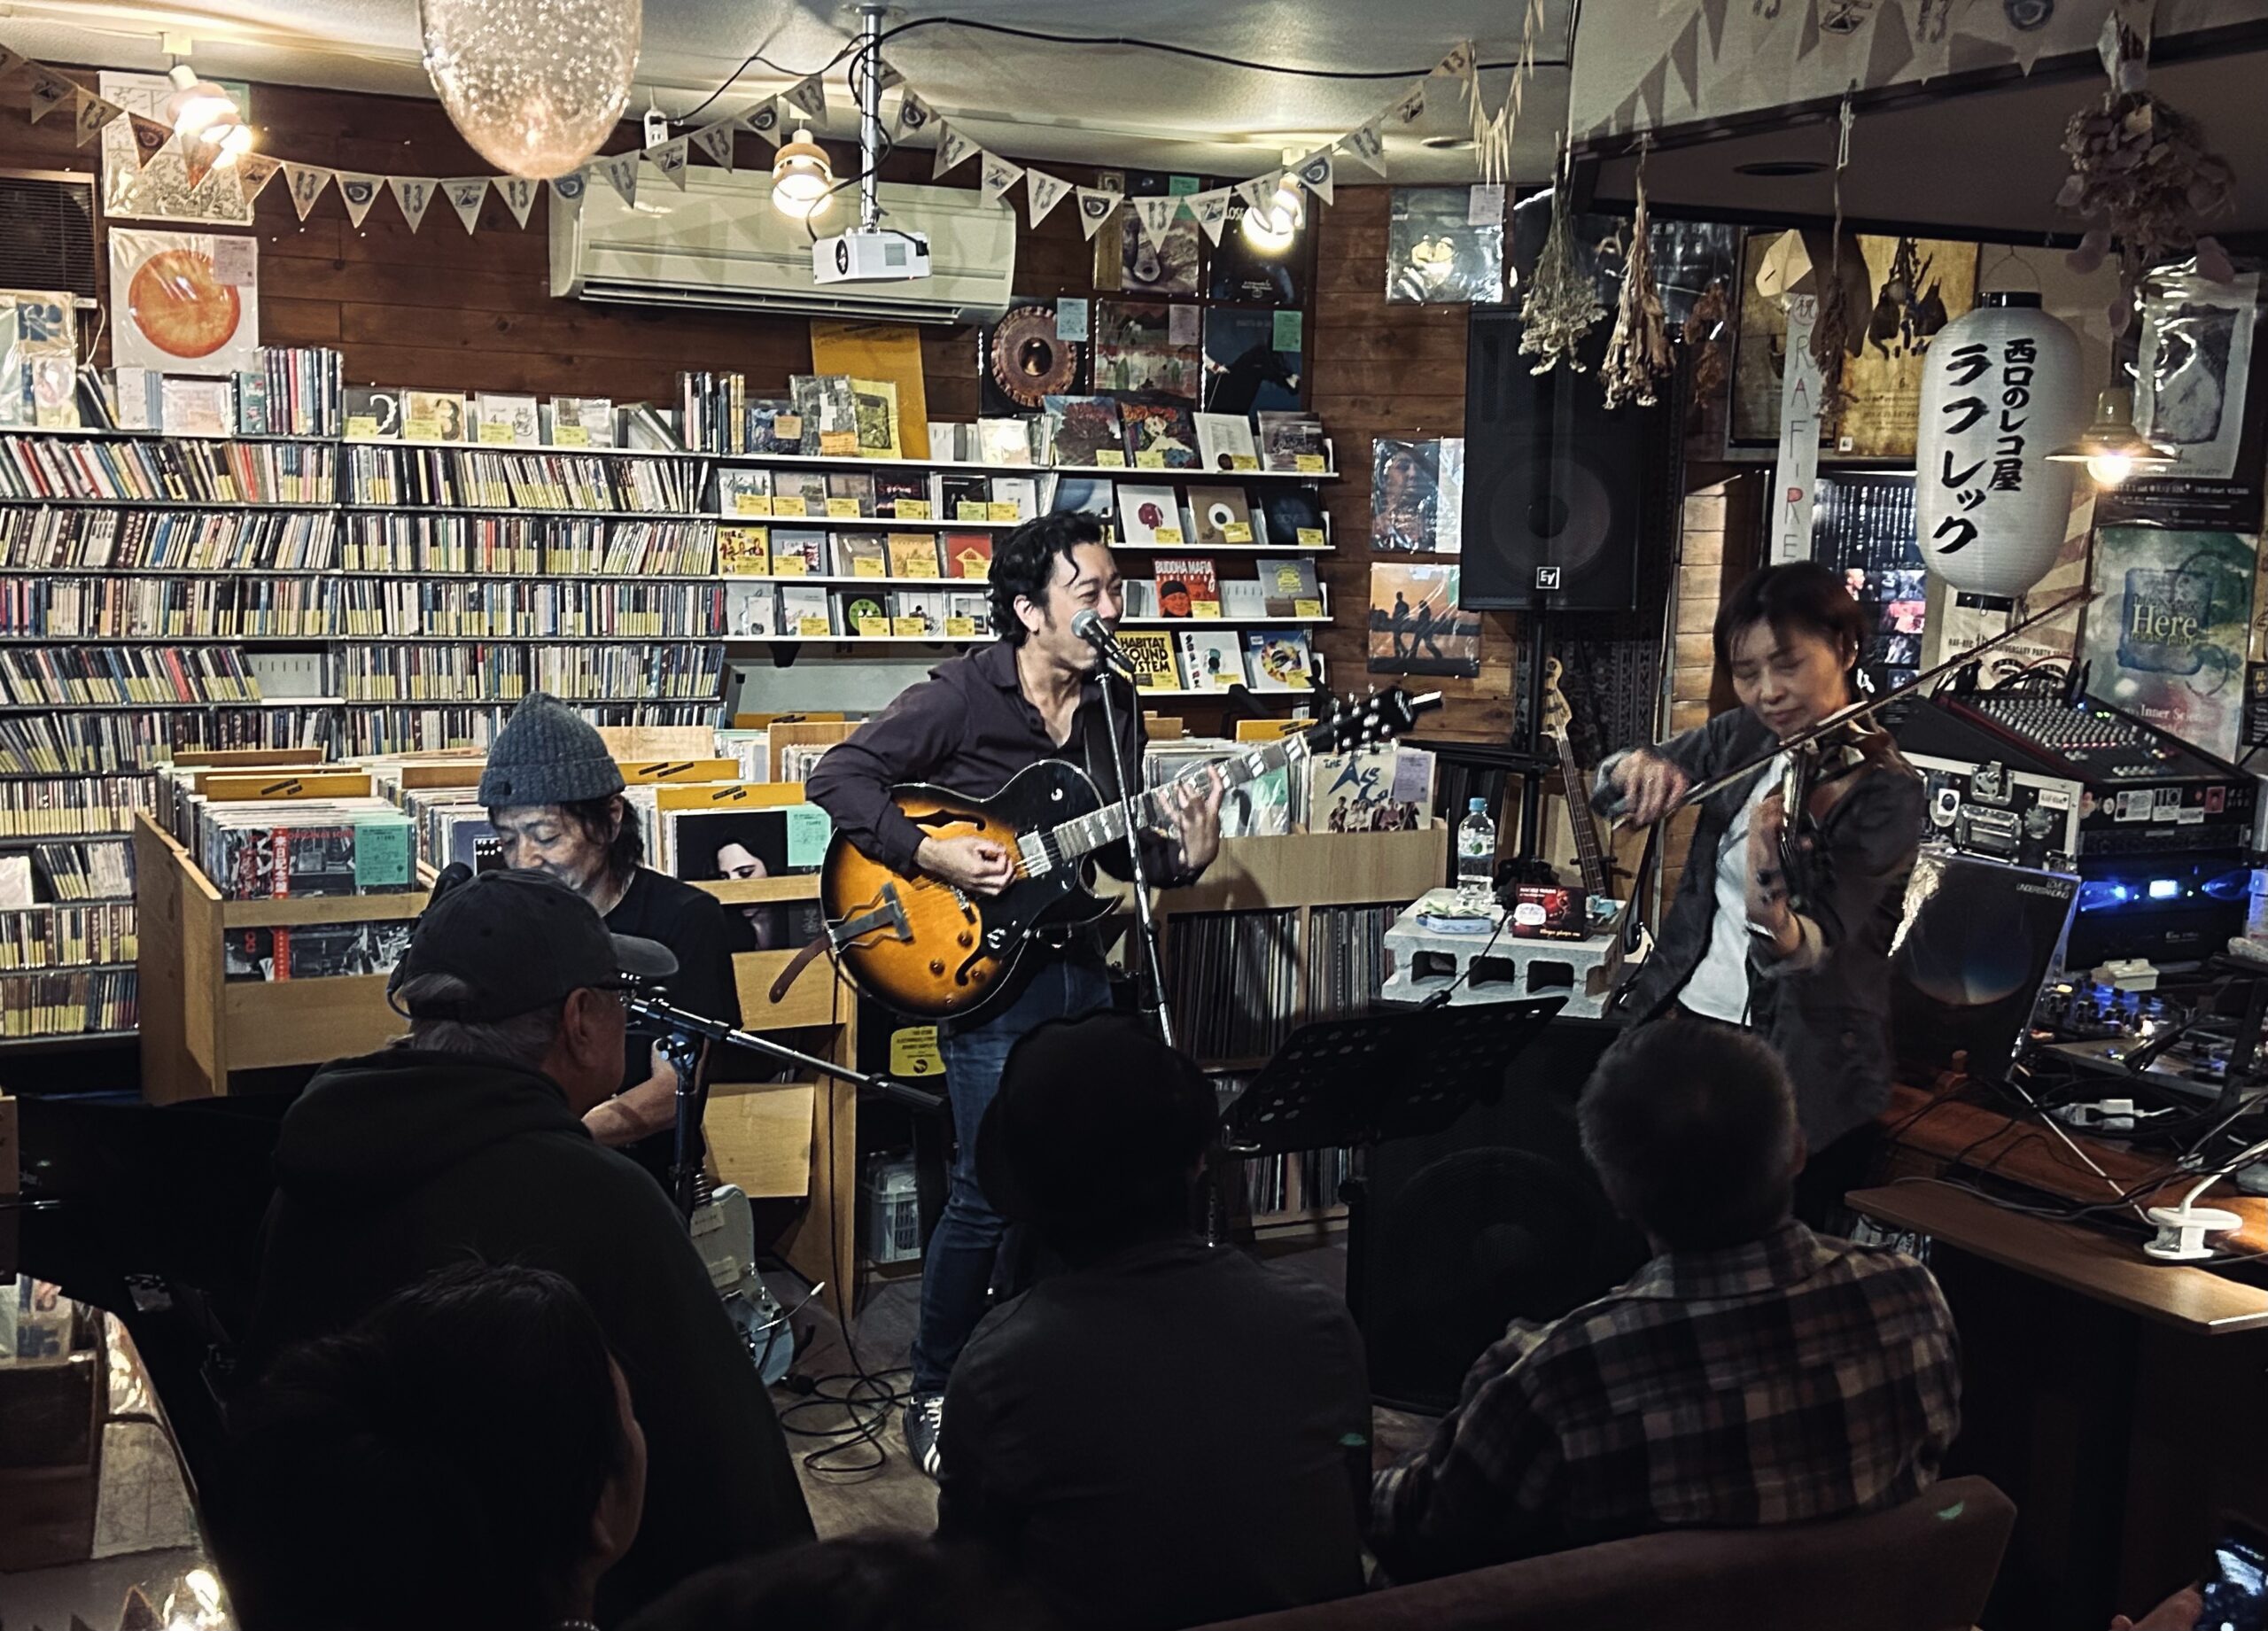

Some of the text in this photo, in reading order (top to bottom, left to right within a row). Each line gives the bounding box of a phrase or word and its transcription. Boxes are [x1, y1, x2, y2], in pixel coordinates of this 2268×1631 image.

[294, 170, 317, 202] 13
[402, 183, 423, 214] 13
[508, 180, 529, 209] 13
[1034, 178, 1058, 211] 13
[1148, 201, 1169, 230] 13
[1987, 338, 2038, 492] 西口のレコ屋
[1931, 343, 1993, 555] ラフレック
[1154, 561, 1214, 574] BUDDHA MAFIA
[2132, 603, 2198, 638] Here
[1120, 637, 1166, 649] HABITAT
[2140, 703, 2171, 719] Inner
[275, 835, 289, 893] 来日記念盤
